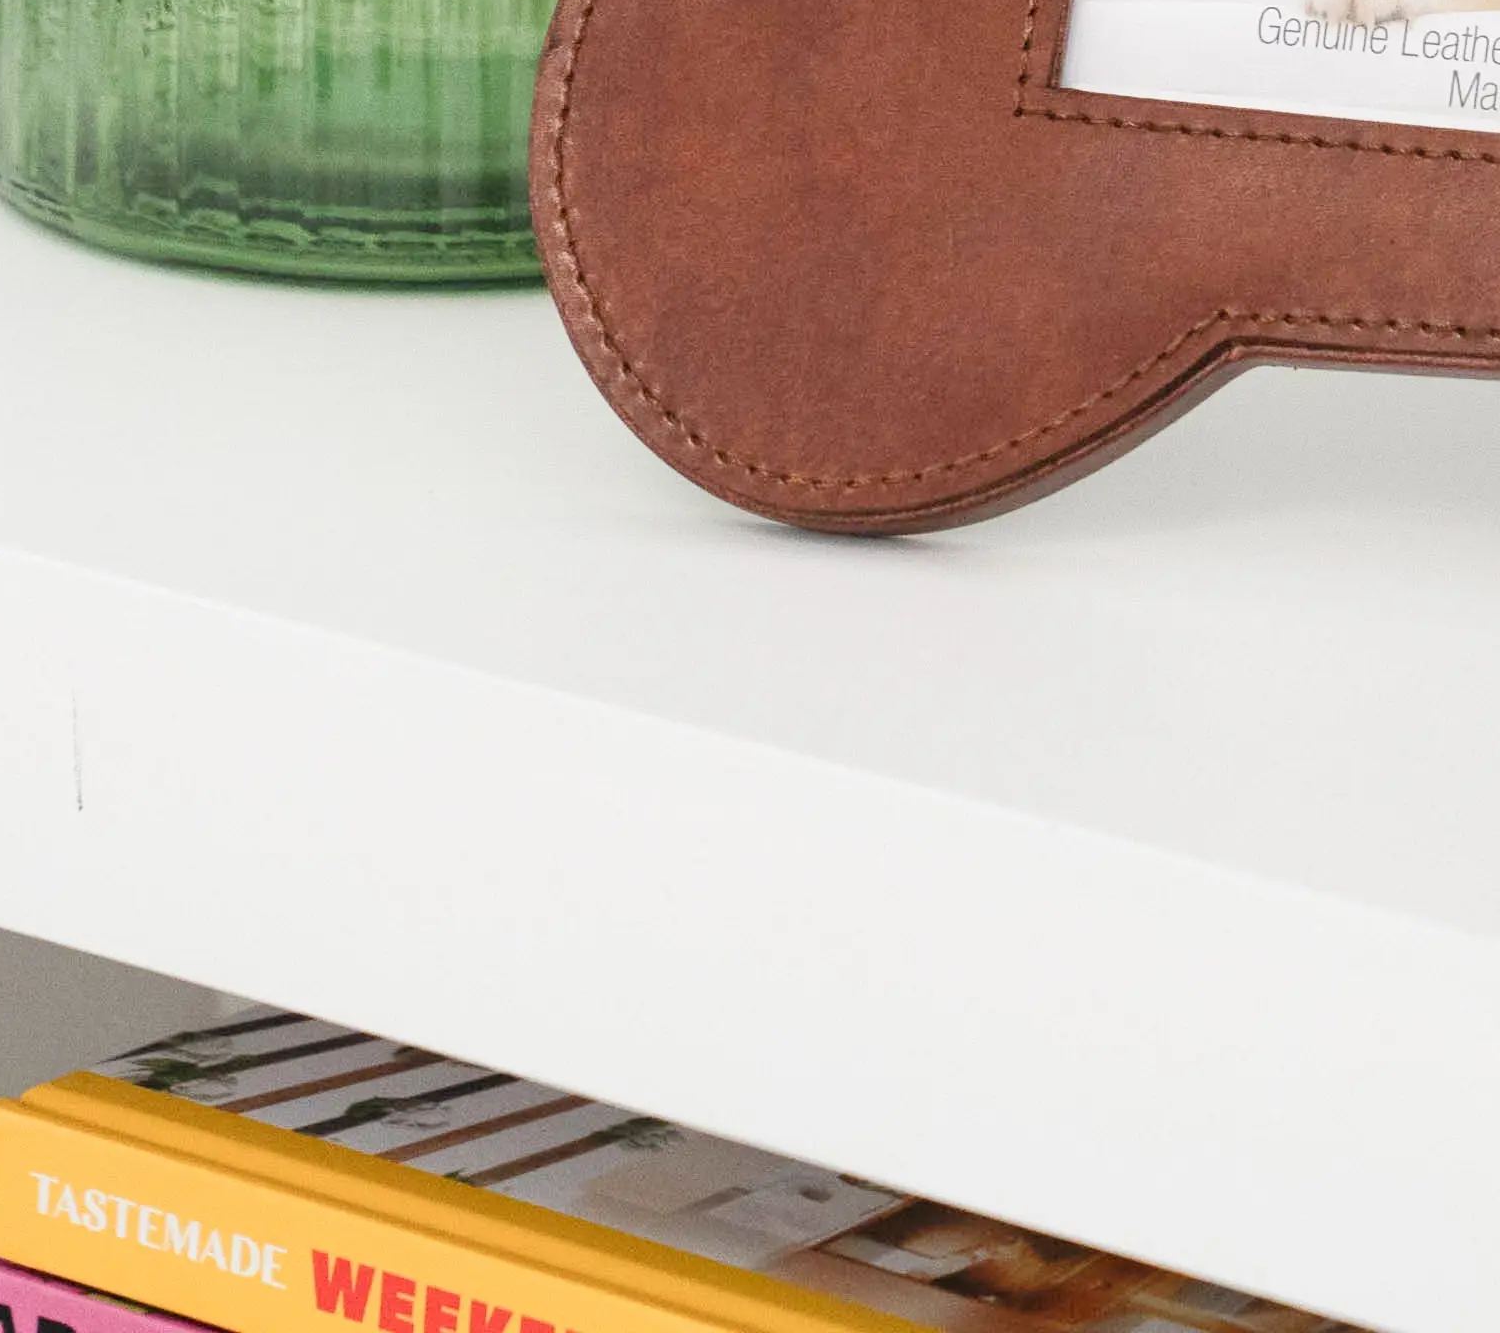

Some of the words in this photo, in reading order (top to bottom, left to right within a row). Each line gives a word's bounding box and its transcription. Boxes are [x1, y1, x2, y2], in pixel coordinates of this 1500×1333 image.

[1257, 5, 1389, 54] Genuine
[29, 1171, 288, 1290] TASTEMADE
[311, 1248, 583, 1333] WEEK
